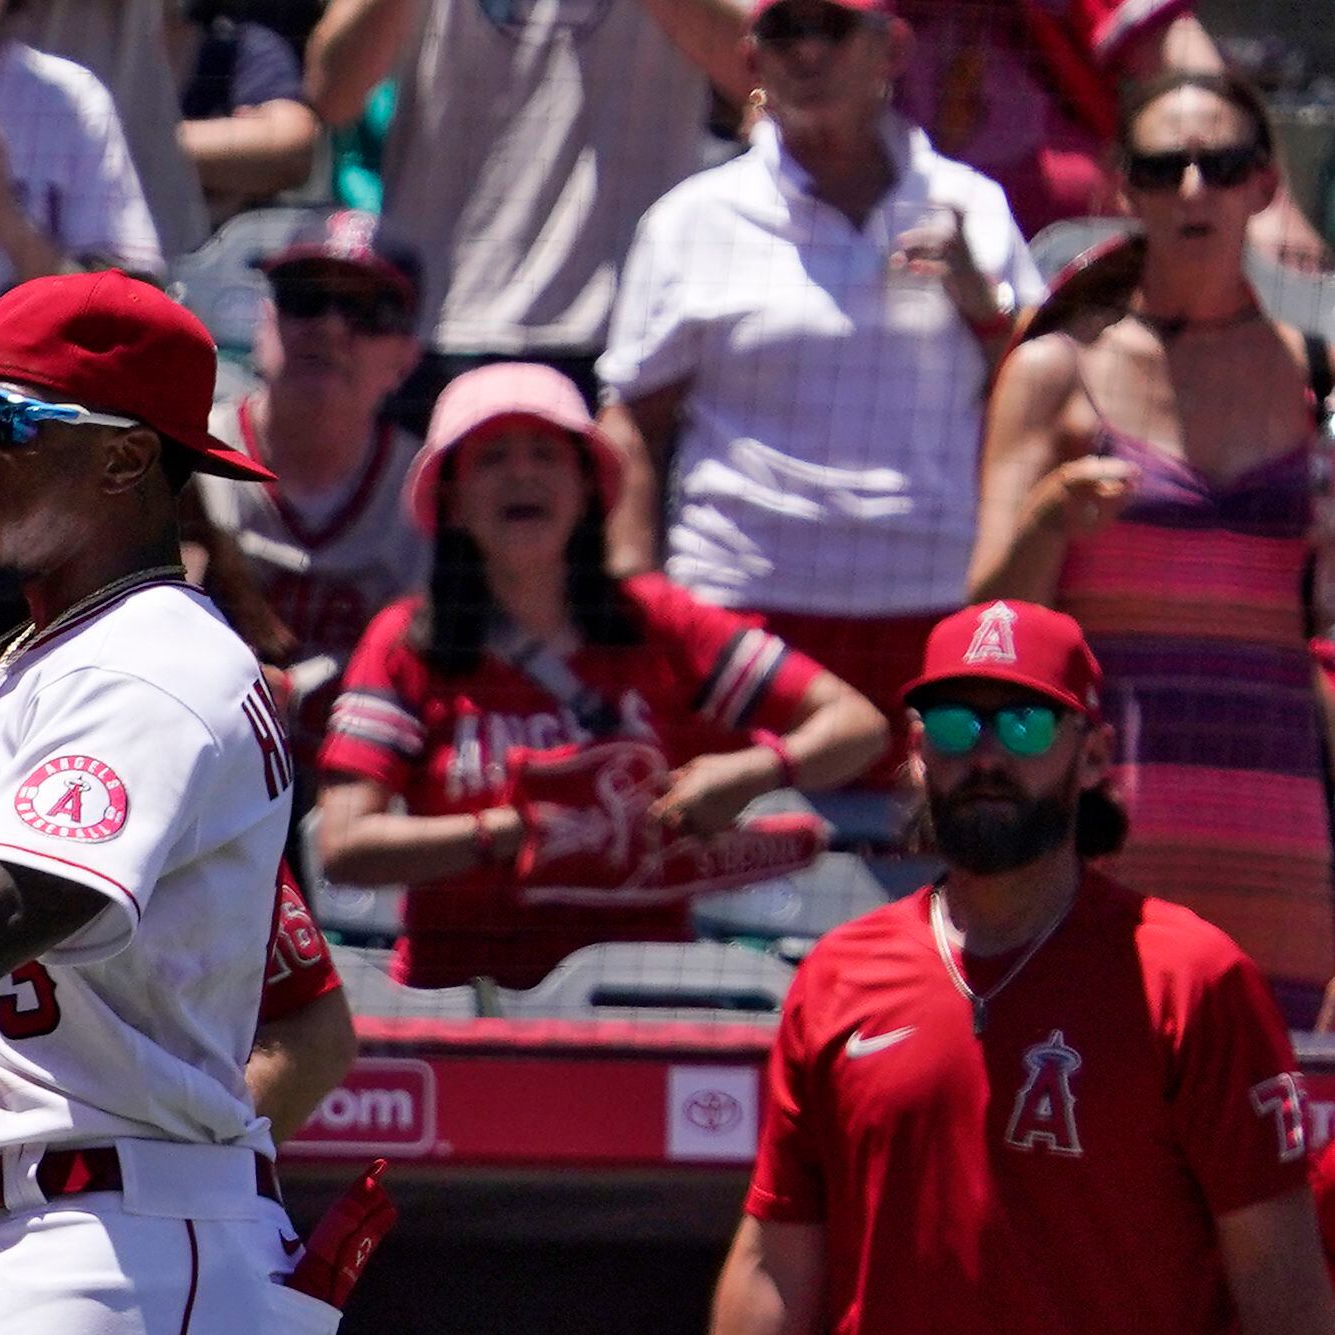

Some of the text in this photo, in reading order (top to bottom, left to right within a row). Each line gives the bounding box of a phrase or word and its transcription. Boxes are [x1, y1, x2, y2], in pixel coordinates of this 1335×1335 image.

[962, 600, 1018, 664] A
[43, 755, 121, 790] ANGELS
[46, 776, 91, 824] A
[304, 1086, 414, 1131] om
[1004, 1029, 1084, 1158] A
